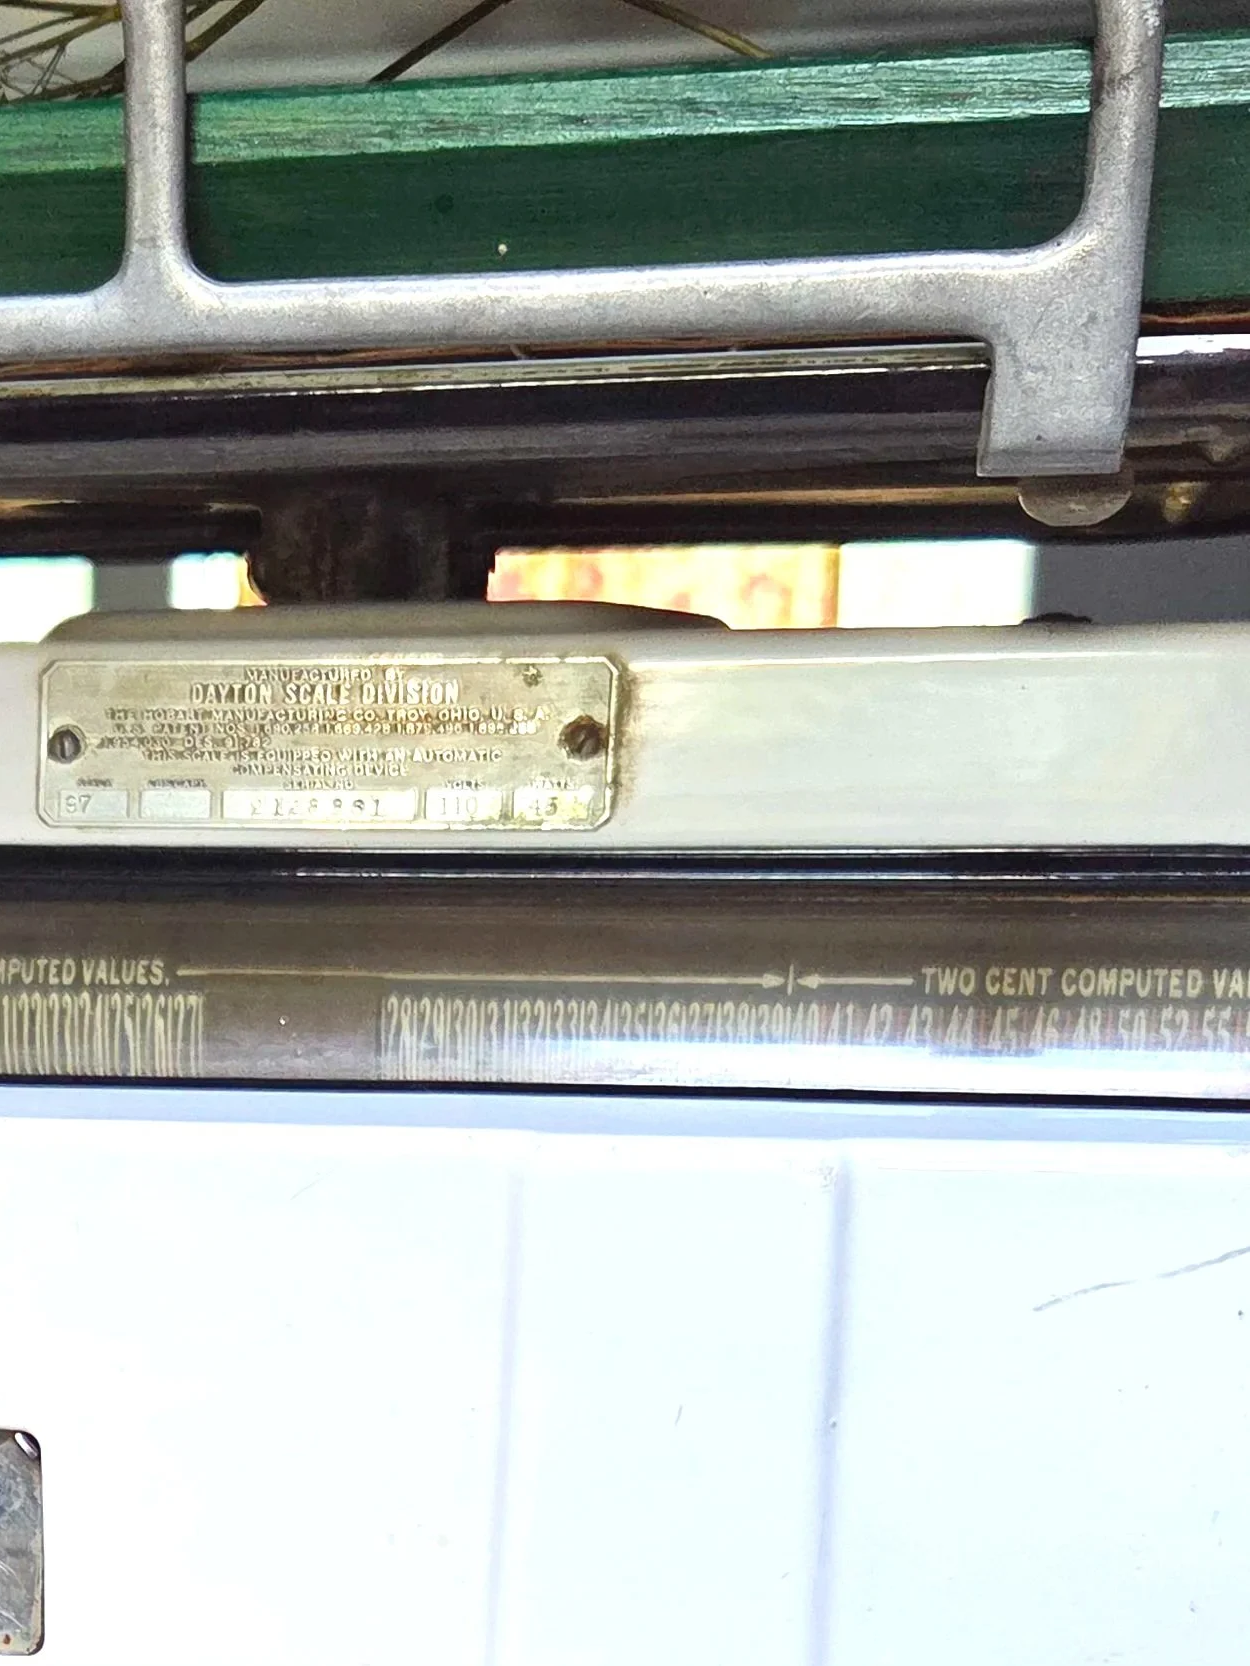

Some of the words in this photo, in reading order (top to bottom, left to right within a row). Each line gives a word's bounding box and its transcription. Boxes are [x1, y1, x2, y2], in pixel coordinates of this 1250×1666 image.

[246, 667, 371, 682] MANUFACTURED
[385, 666, 404, 682] BY
[191, 682, 272, 705] DAYTON
[285, 682, 351, 705] SCALE
[362, 679, 459, 706] DIVISION
[145, 708, 203, 722] HOBART
[212, 708, 348, 722] MANUFACTURING
[353, 709, 379, 722] CO.
[141, 750, 177, 763] THIS
[184, 750, 230, 763] SCALE
[257, 750, 331, 763] EQUIPPED
[339, 749, 378, 763] WITH
[385, 749, 407, 763] AN
[412, 749, 502, 762] AUTOMATIC
[232, 763, 347, 777] COMPENSATING
[354, 763, 408, 777] DEVICE
[921, 967, 976, 997] TWO
[985, 967, 1054, 997] CENT
[1061, 967, 1204, 998] COMPUTED
[1213, 968, 1250, 999] VA
